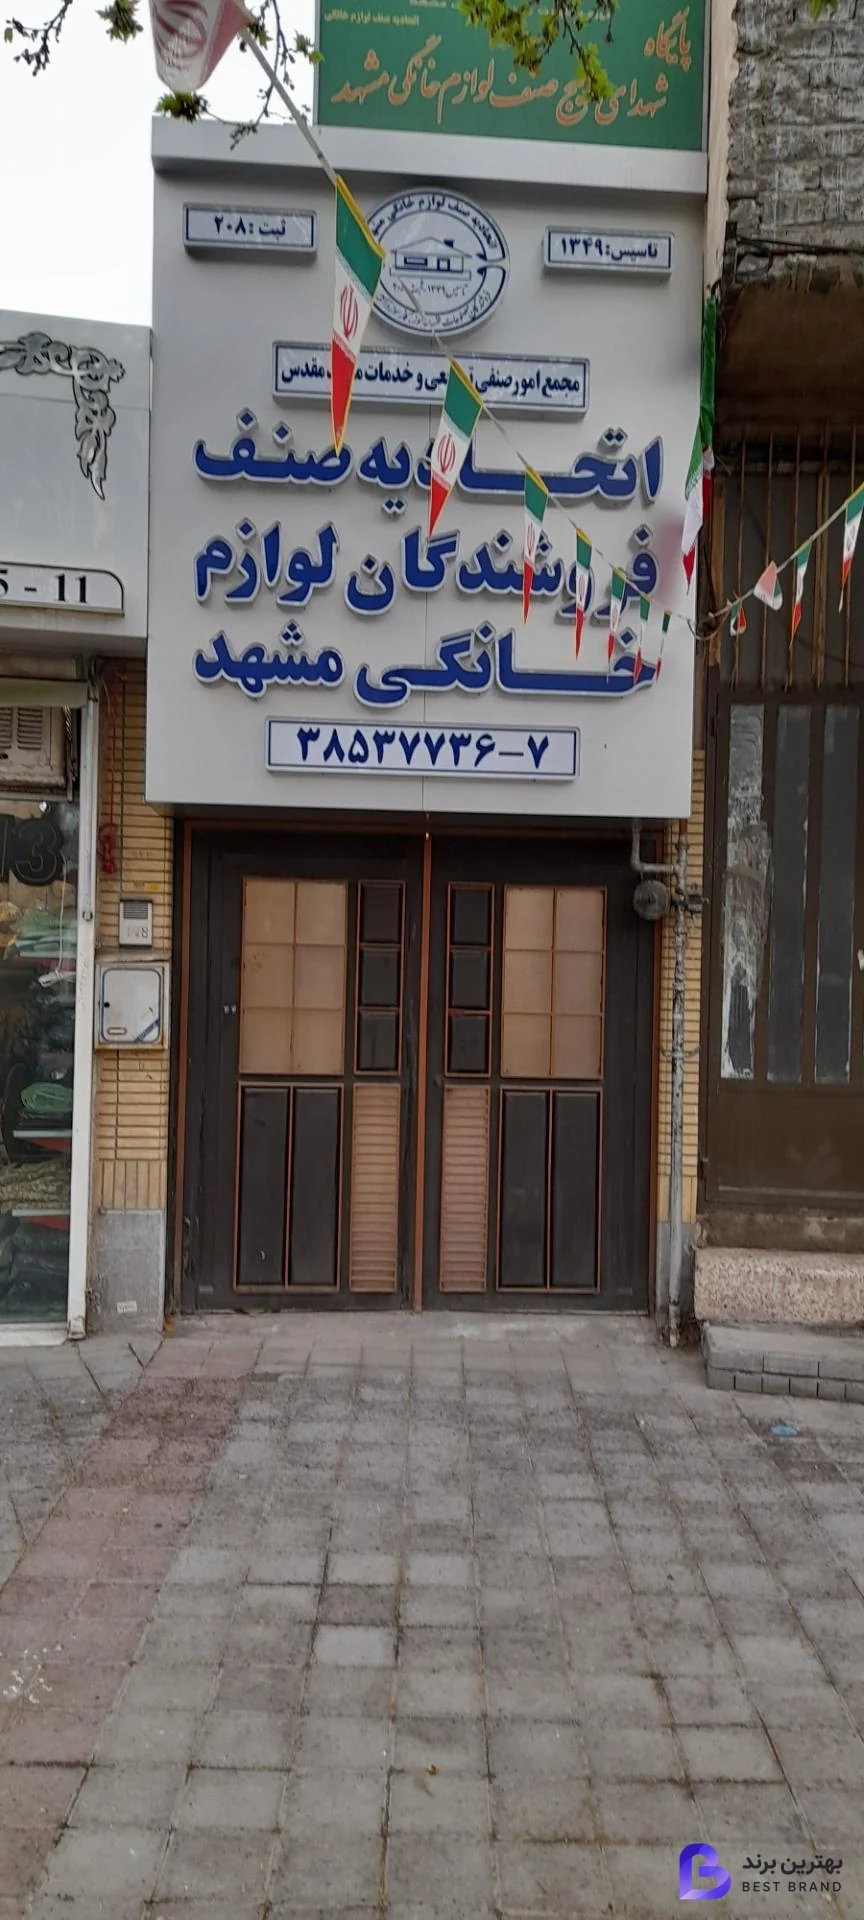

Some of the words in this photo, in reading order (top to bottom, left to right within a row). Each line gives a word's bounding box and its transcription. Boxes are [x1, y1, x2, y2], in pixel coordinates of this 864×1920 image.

[644, 5, 692, 72] پایگاه
[331, 49, 390, 105] مشهد
[388, 35, 443, 106] خانگی
[435, 58, 495, 126] لوازم
[281, 357, 325, 383] مقدس
[364, 360, 413, 383] خدمات
[414, 371, 423, 391] و
[475, 366, 513, 394] صنفی
[512, 369, 541, 396] امور
[541, 370, 580, 398] مجمع
[194, 408, 353, 486] صنف
[358, 427, 663, 516] اتحادیه
[54, 573, 88, 603] 11
[194, 518, 340, 607] لوازم
[193, 619, 345, 697] مشهد
[354, 621, 658, 708] خانگی
